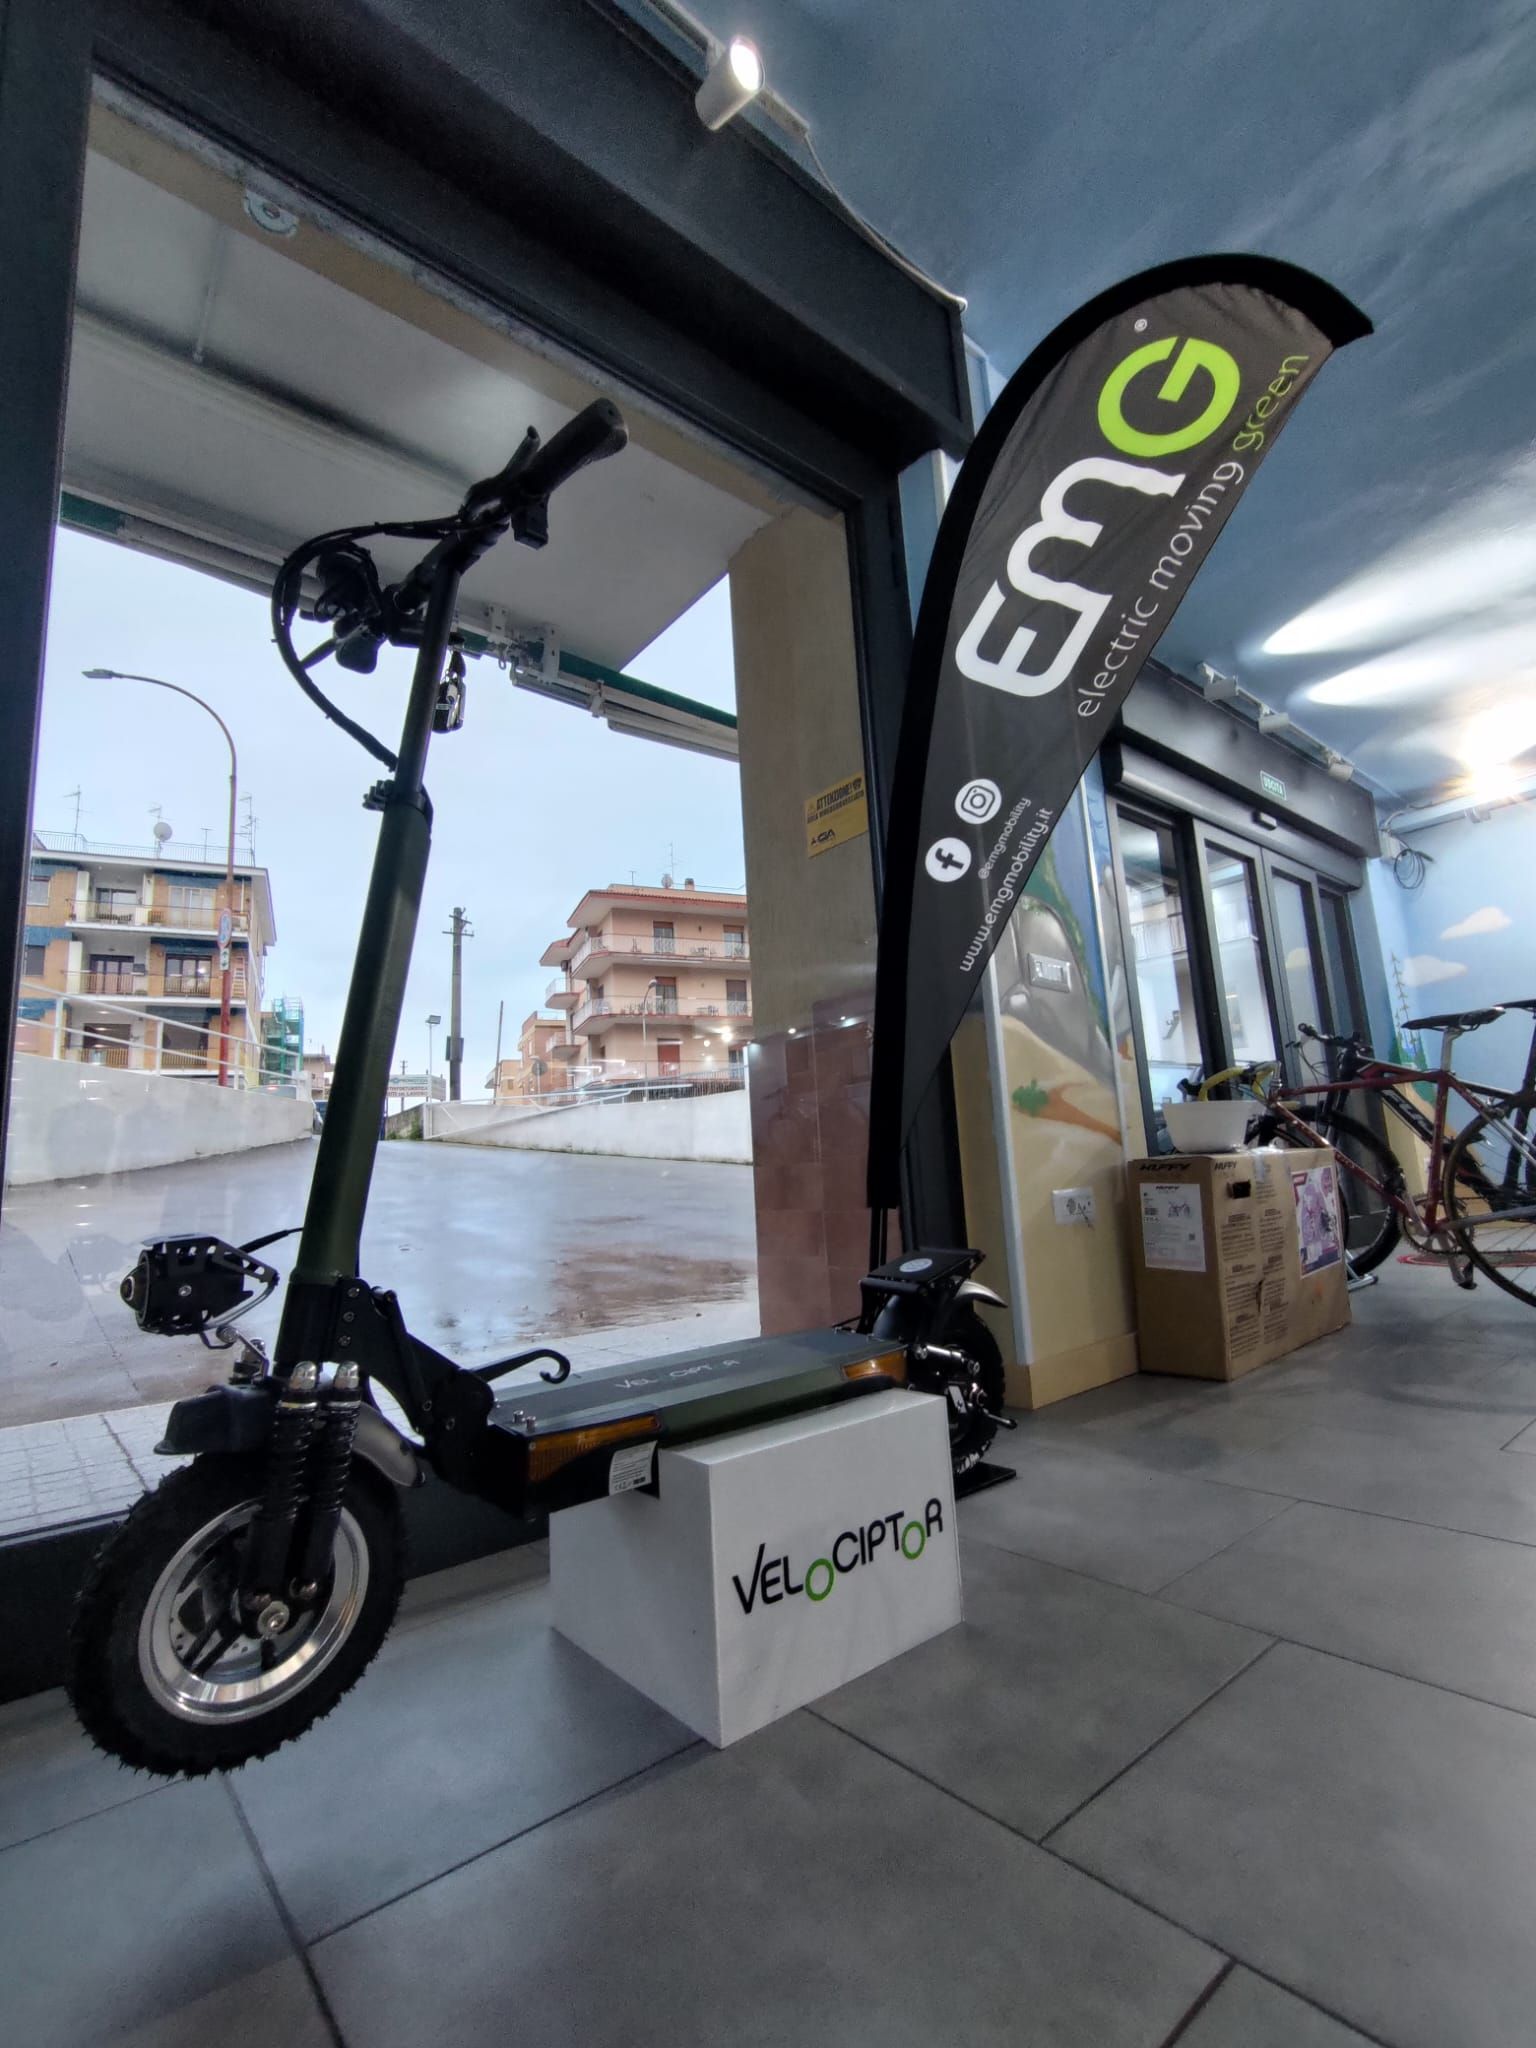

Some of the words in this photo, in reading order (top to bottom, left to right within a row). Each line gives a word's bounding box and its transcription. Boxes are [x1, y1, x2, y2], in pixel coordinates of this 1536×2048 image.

[1077, 596, 1158, 717] electric
[1149, 461, 1245, 591] moving
[1233, 354, 1310, 453] green
[978, 797, 1031, 880] @emgmobility
[960, 807, 1053, 972] www.emgmobility.it
[1140, 1162, 1192, 1171] HUFFY
[1214, 1160, 1238, 1171] HUFFY
[732, 1497, 943, 1615] VELOCIPTOR
